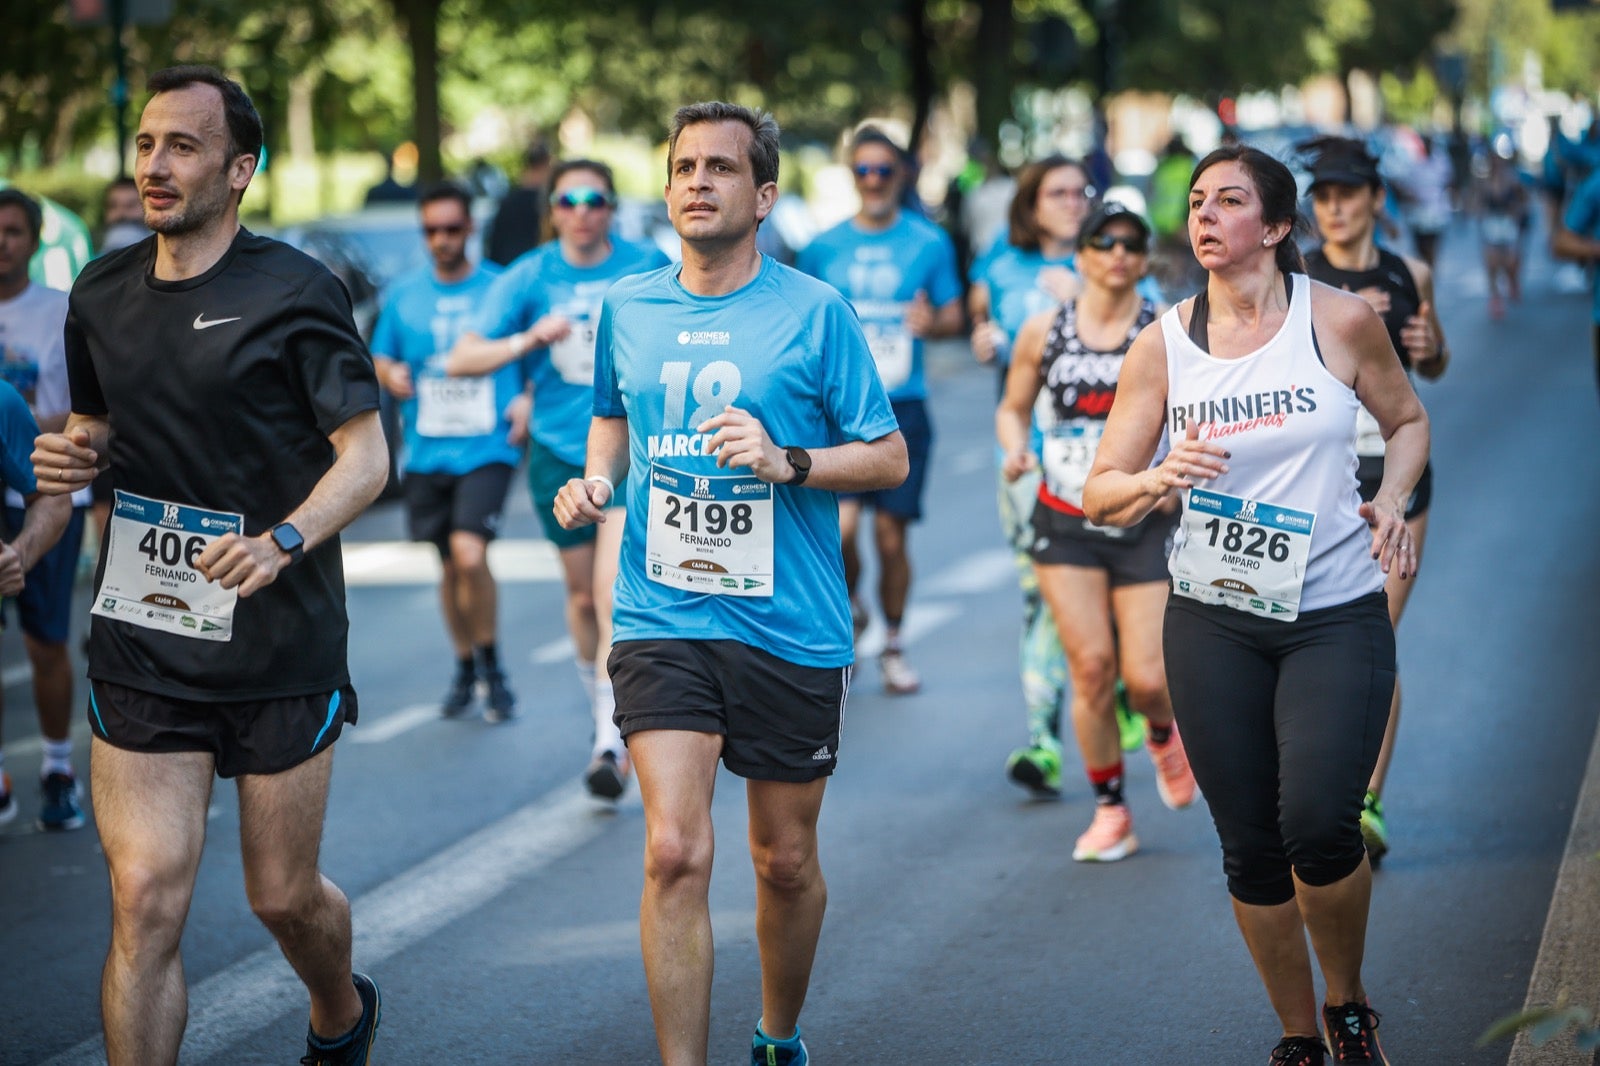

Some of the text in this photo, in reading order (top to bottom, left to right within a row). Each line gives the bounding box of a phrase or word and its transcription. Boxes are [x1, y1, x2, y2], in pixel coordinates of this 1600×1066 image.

[692, 331, 730, 339] OXIMESA
[659, 360, 741, 430] 18
[1172, 385, 1317, 433] RUNNER'S
[694, 477, 709, 493] 18
[163, 504, 180, 522] 18
[664, 495, 753, 535] 2198
[1285, 515, 1310, 524] OXIMESA
[138, 527, 207, 569] 406
[680, 533, 732, 548] FERNANDO
[1205, 517, 1291, 562] 1826
[1220, 553, 1261, 571] AMPARO
[145, 564, 197, 583] FERNANDO
